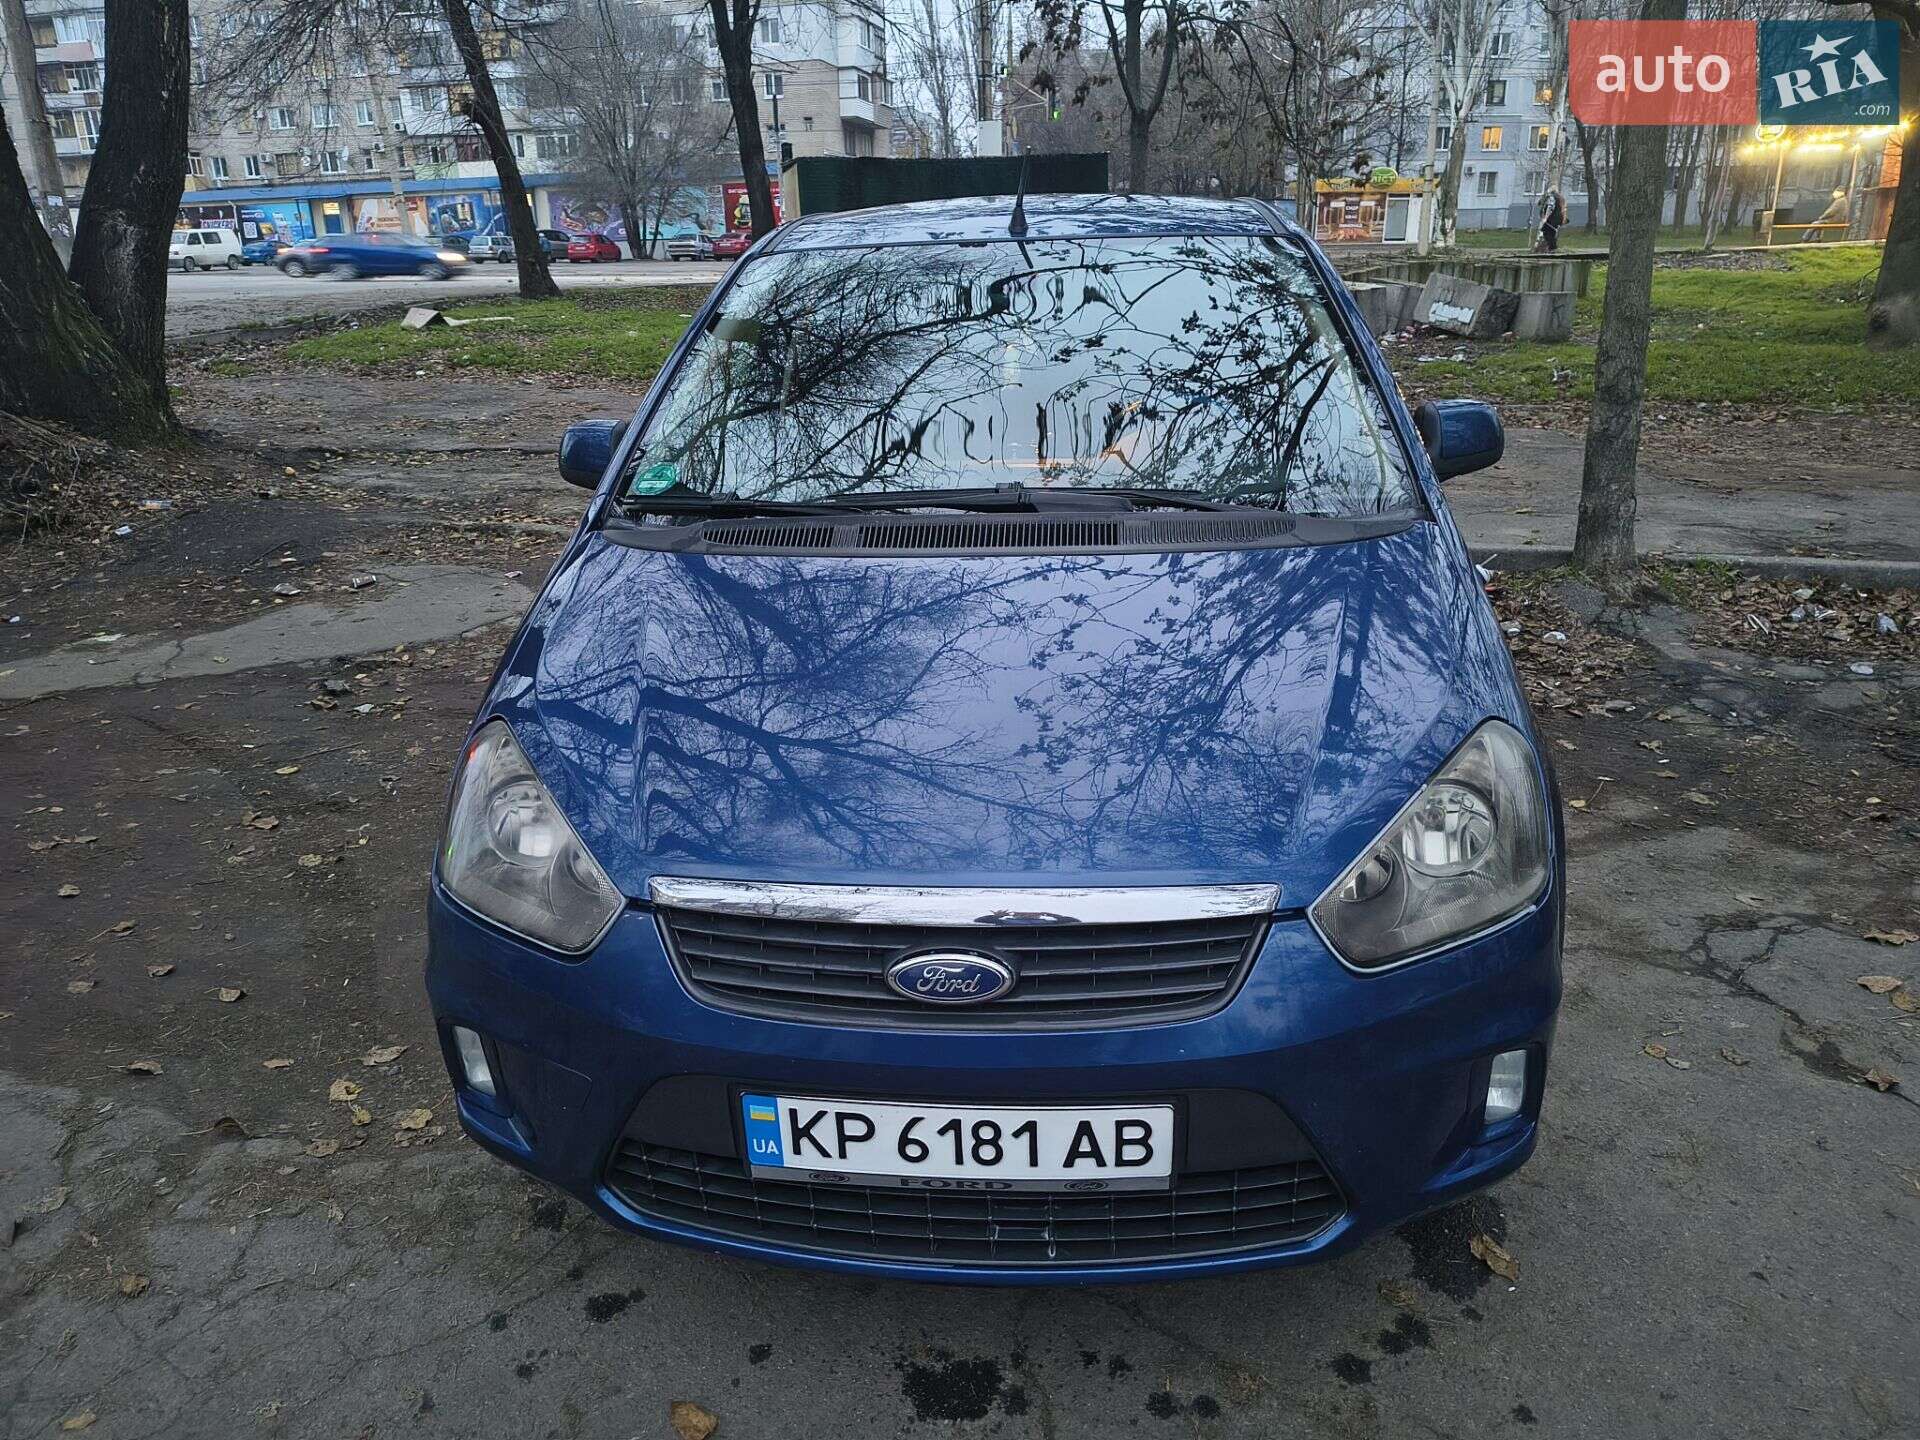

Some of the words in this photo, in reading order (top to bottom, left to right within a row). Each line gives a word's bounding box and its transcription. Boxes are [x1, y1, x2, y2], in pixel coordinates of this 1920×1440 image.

[916, 965, 982, 993] Ford
[753, 1138, 780, 1155] UA
[788, 1107, 876, 1160] KP
[897, 1116, 1039, 1168] 6181
[1062, 1119, 1154, 1168] AB
[900, 1177, 1013, 1191] FORD
